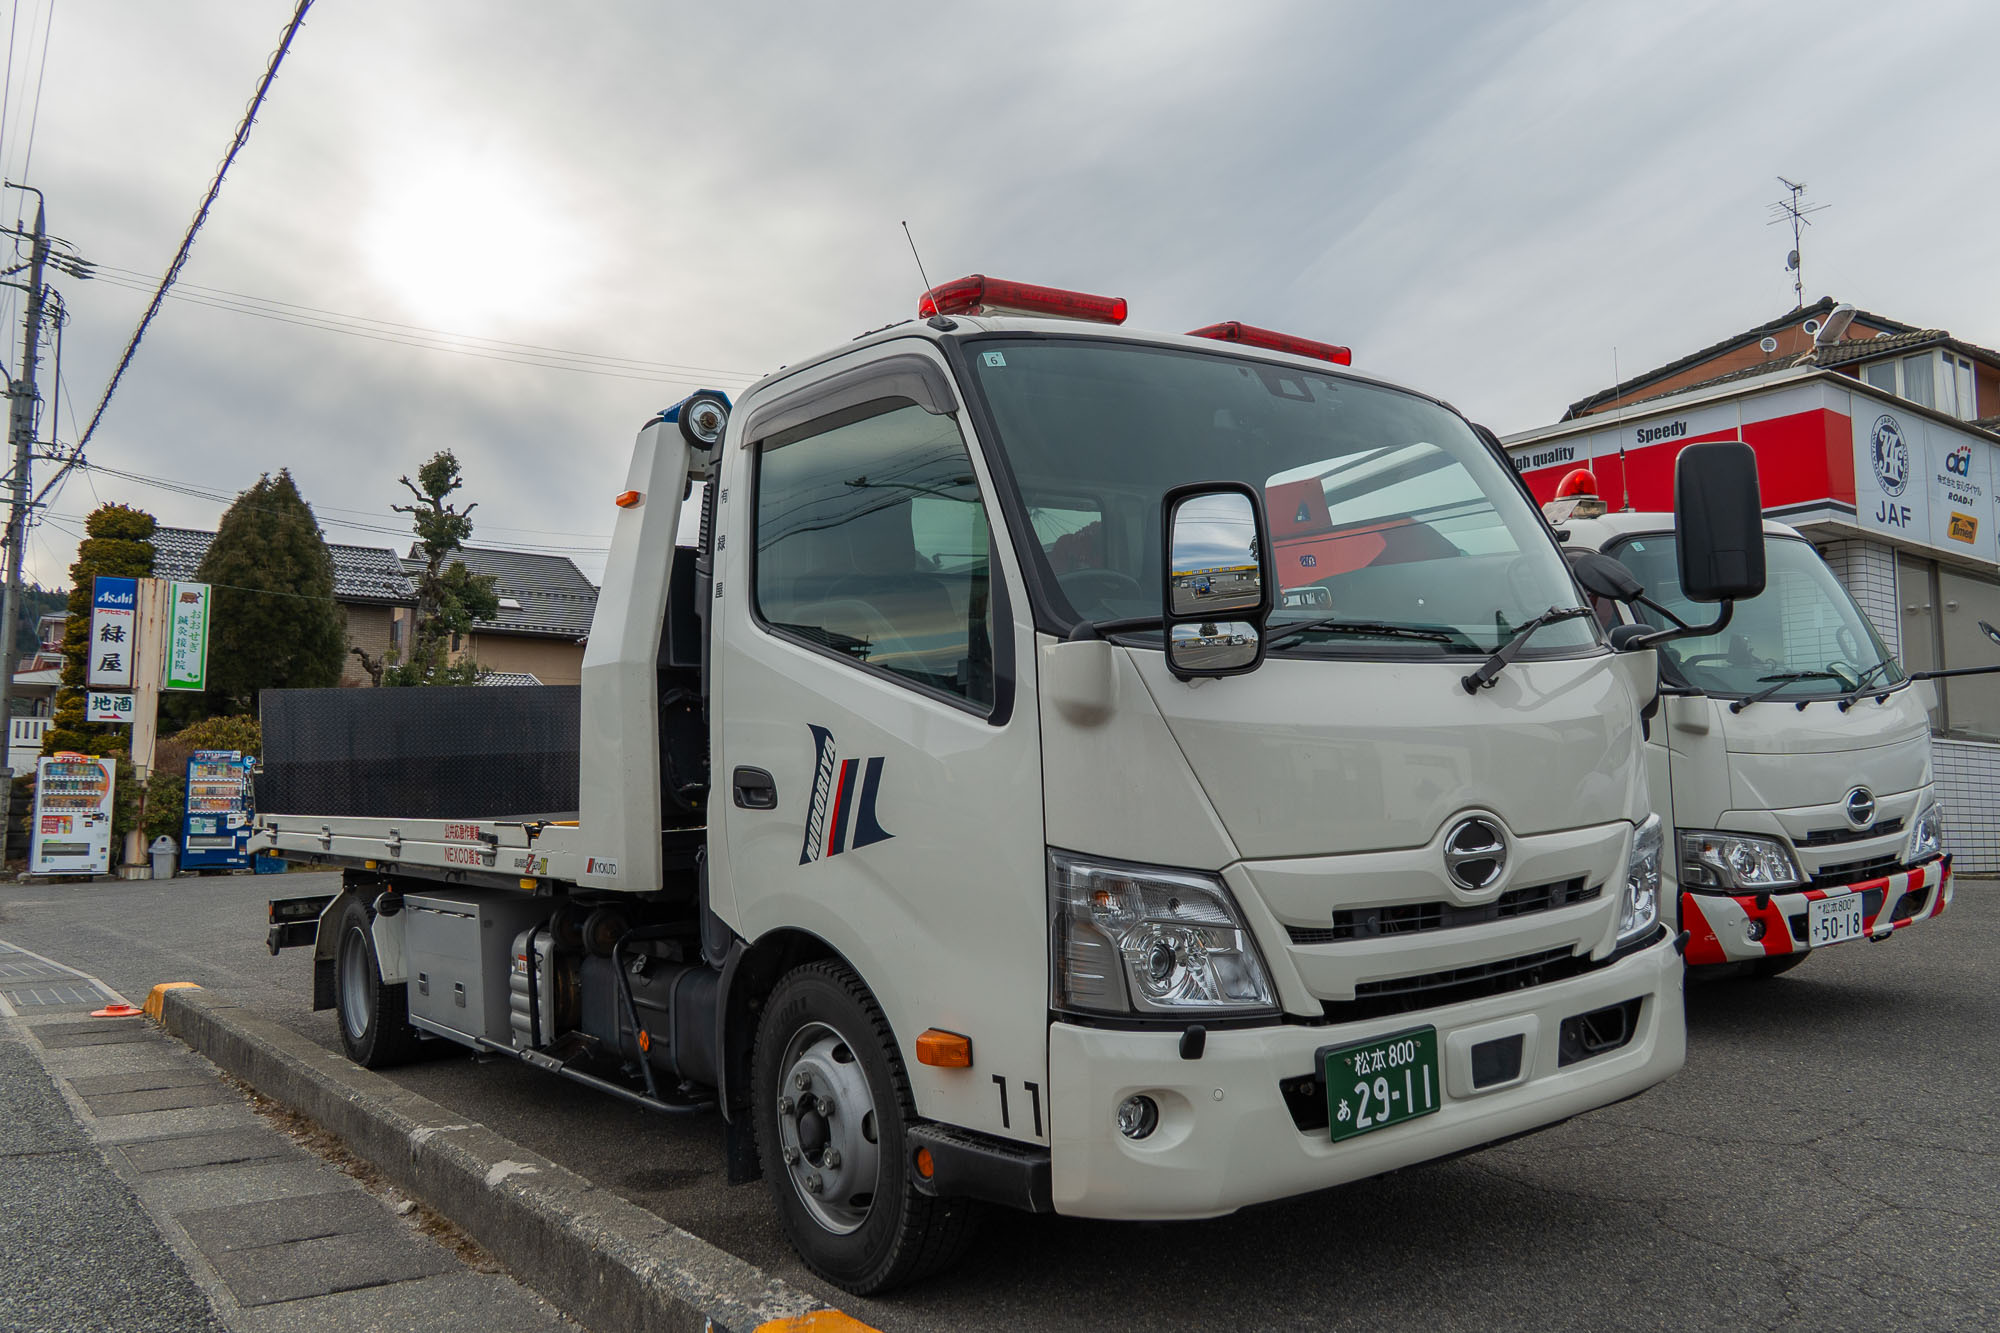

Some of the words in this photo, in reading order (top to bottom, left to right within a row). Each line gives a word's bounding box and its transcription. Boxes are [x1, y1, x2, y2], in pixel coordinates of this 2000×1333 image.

[1636, 421, 1687, 443] Speedy
[1533, 447, 1575, 468] quality
[1947, 492, 1973, 507] ROAD-1
[1875, 500, 1912, 529] JAF
[97, 591, 134, 605] Asahi
[97, 608, 131, 616] アサヒビール
[175, 615, 189, 671] 鍼灸接骨院
[189, 609, 202, 654] おおせぎ
[97, 622, 127, 672] 緑屋
[92, 695, 132, 712] 地酒
[806, 735, 837, 862] MIDORIYA
[594, 862, 617, 875] KYOKUTO
[1822, 902, 1837, 914] 松本
[1838, 899, 1851, 912] 800
[1821, 912, 1860, 941] 50-18
[1354, 1048, 1387, 1076] 松本
[1388, 1040, 1415, 1067] 800
[991, 1074, 1043, 1137] 11
[1337, 1099, 1351, 1122] あ
[1354, 1064, 1432, 1129] 29-11
